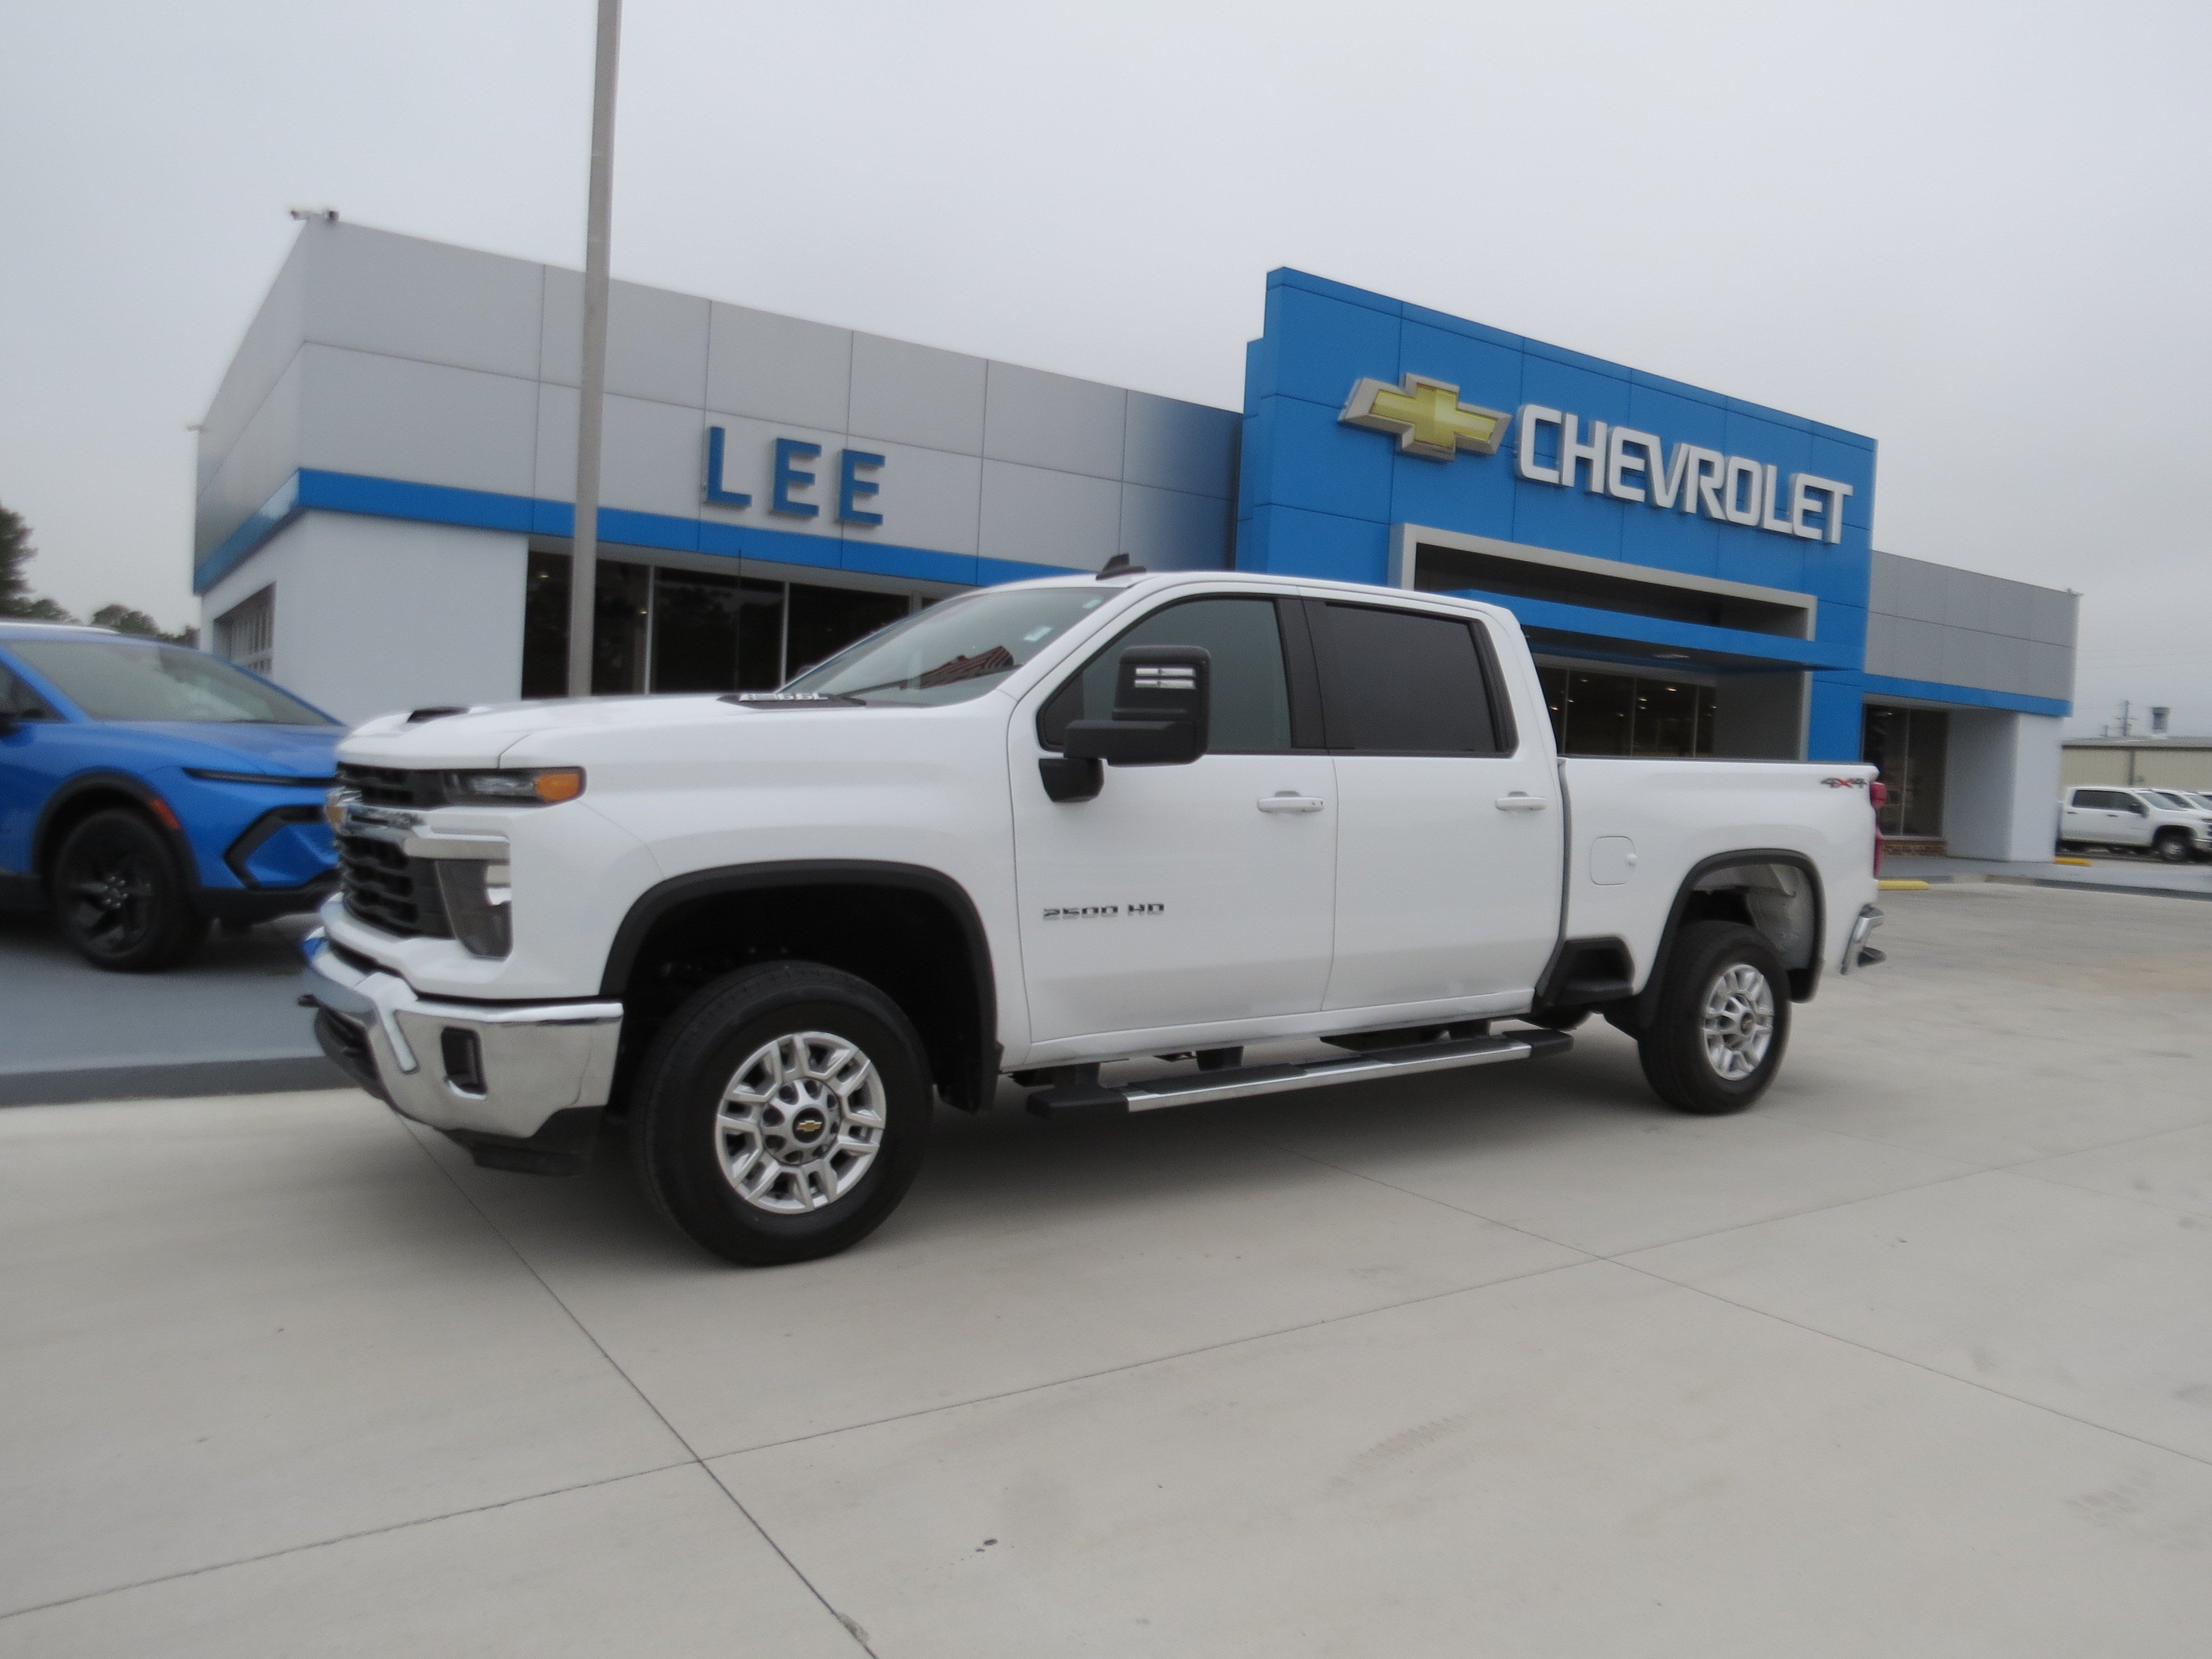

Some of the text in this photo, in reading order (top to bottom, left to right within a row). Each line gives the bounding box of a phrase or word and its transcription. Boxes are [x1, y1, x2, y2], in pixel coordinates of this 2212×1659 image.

[706, 426, 885, 526] LEE
[1515, 403, 1854, 545] CHEVROLET
[1044, 903, 1165, 920] 2500 HD
